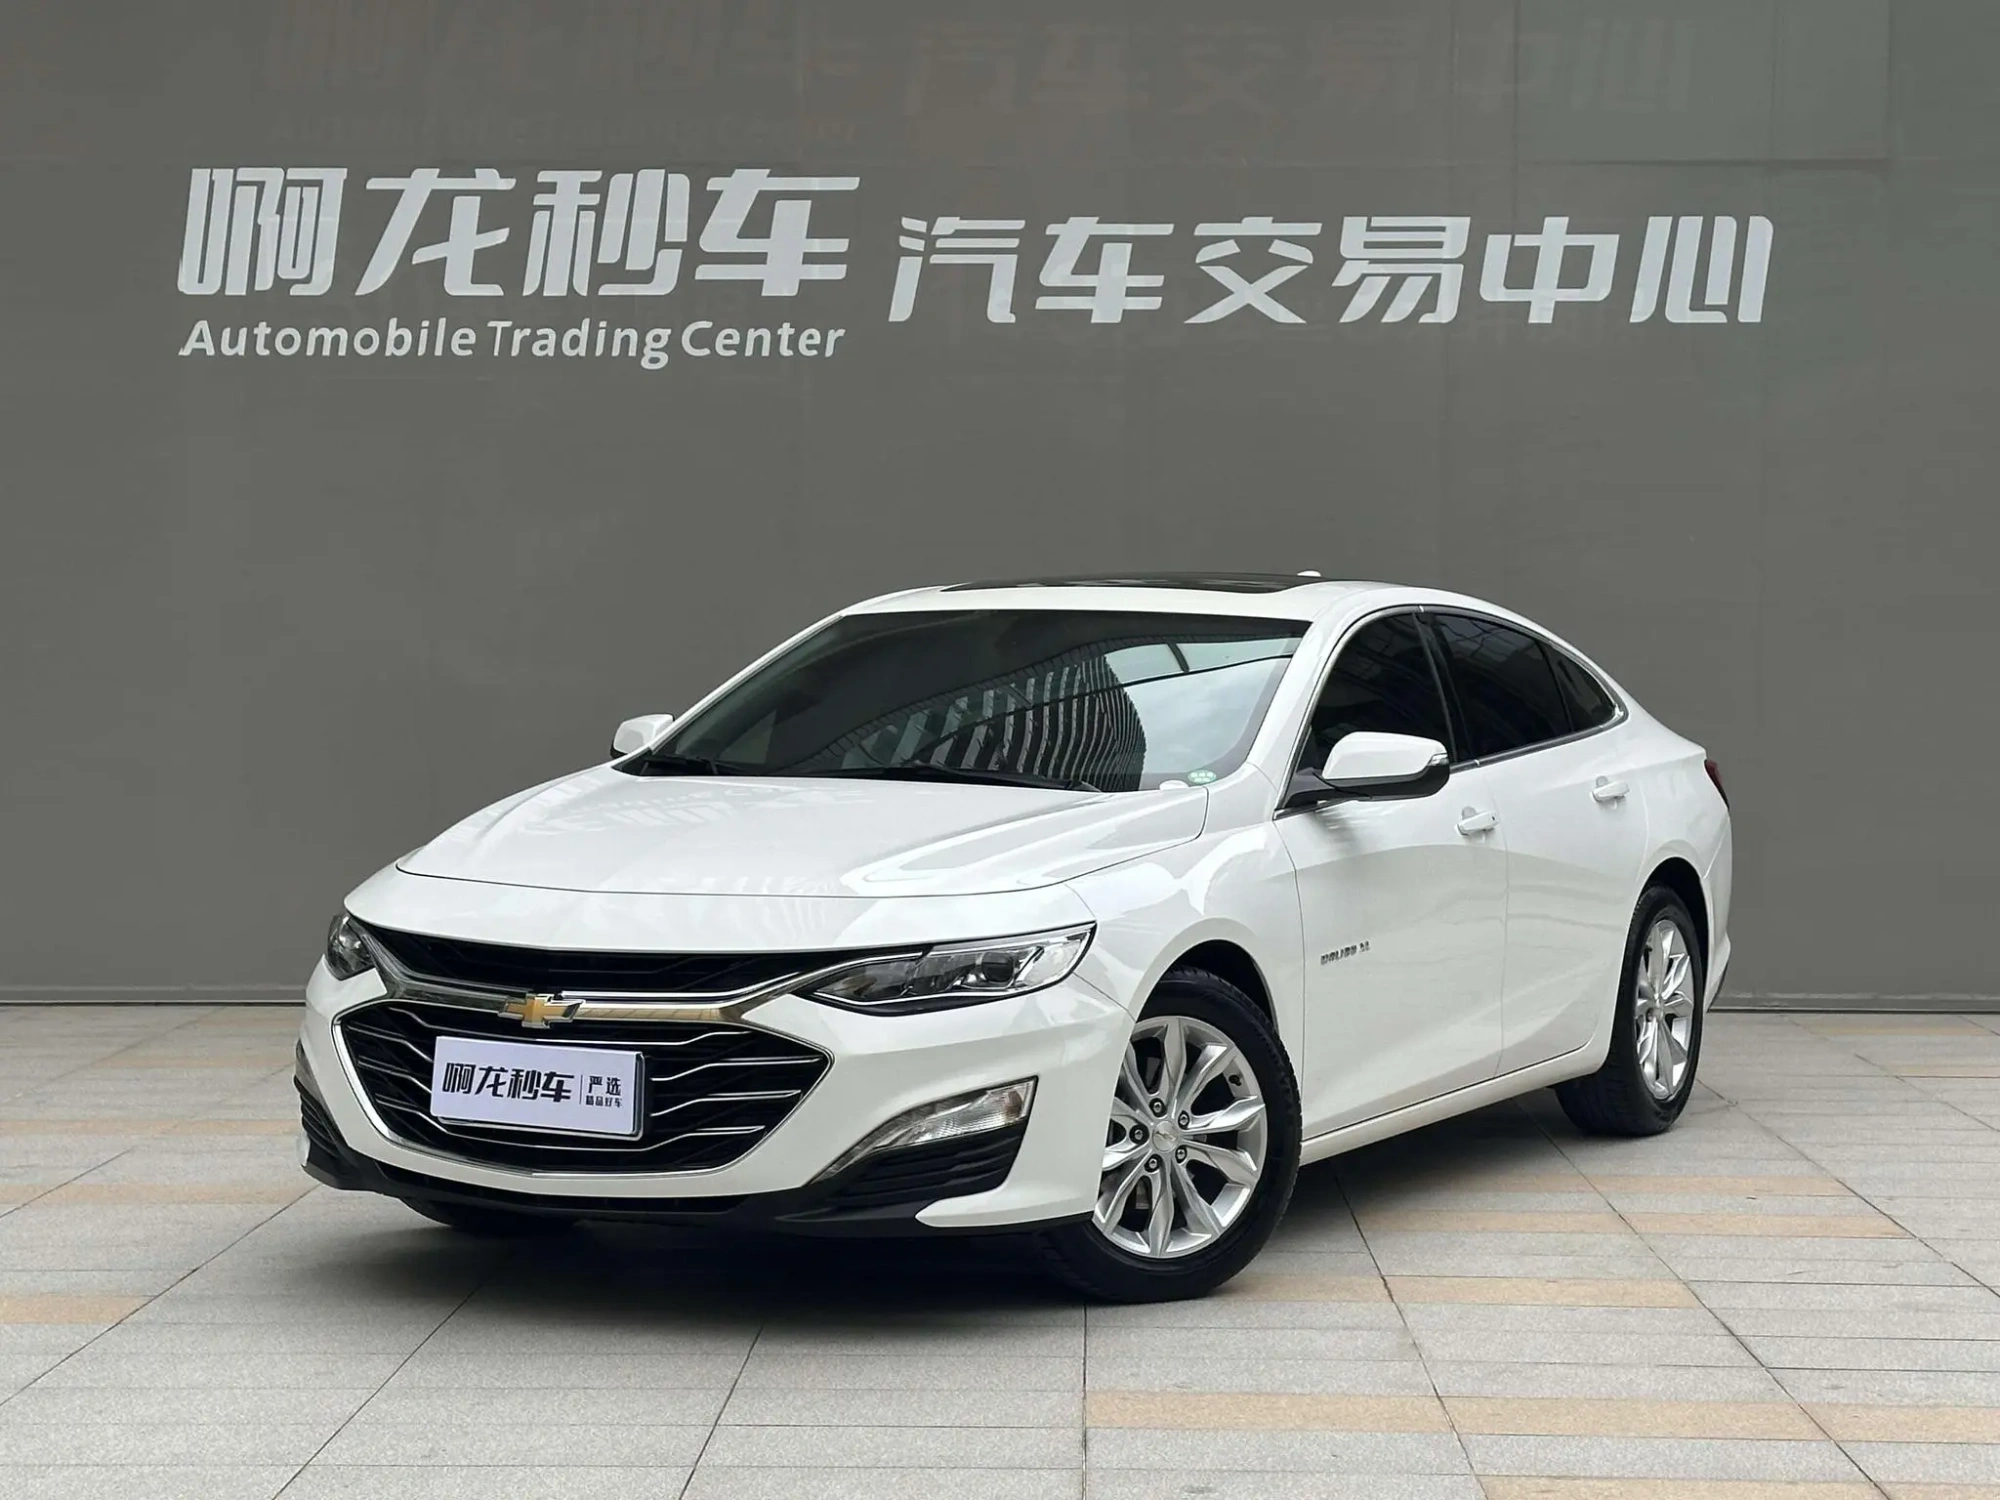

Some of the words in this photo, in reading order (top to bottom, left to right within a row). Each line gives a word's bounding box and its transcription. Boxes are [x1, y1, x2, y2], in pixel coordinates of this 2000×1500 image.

[178, 167, 861, 297] 啊龙秒车
[888, 215, 1774, 324] 汽车交易中心
[178, 317, 477, 357] Automobile
[487, 317, 672, 370] Trading
[681, 320, 846, 358] Center
[442, 1062, 575, 1103] 啊龙秒车
[588, 1075, 622, 1097] 严选
